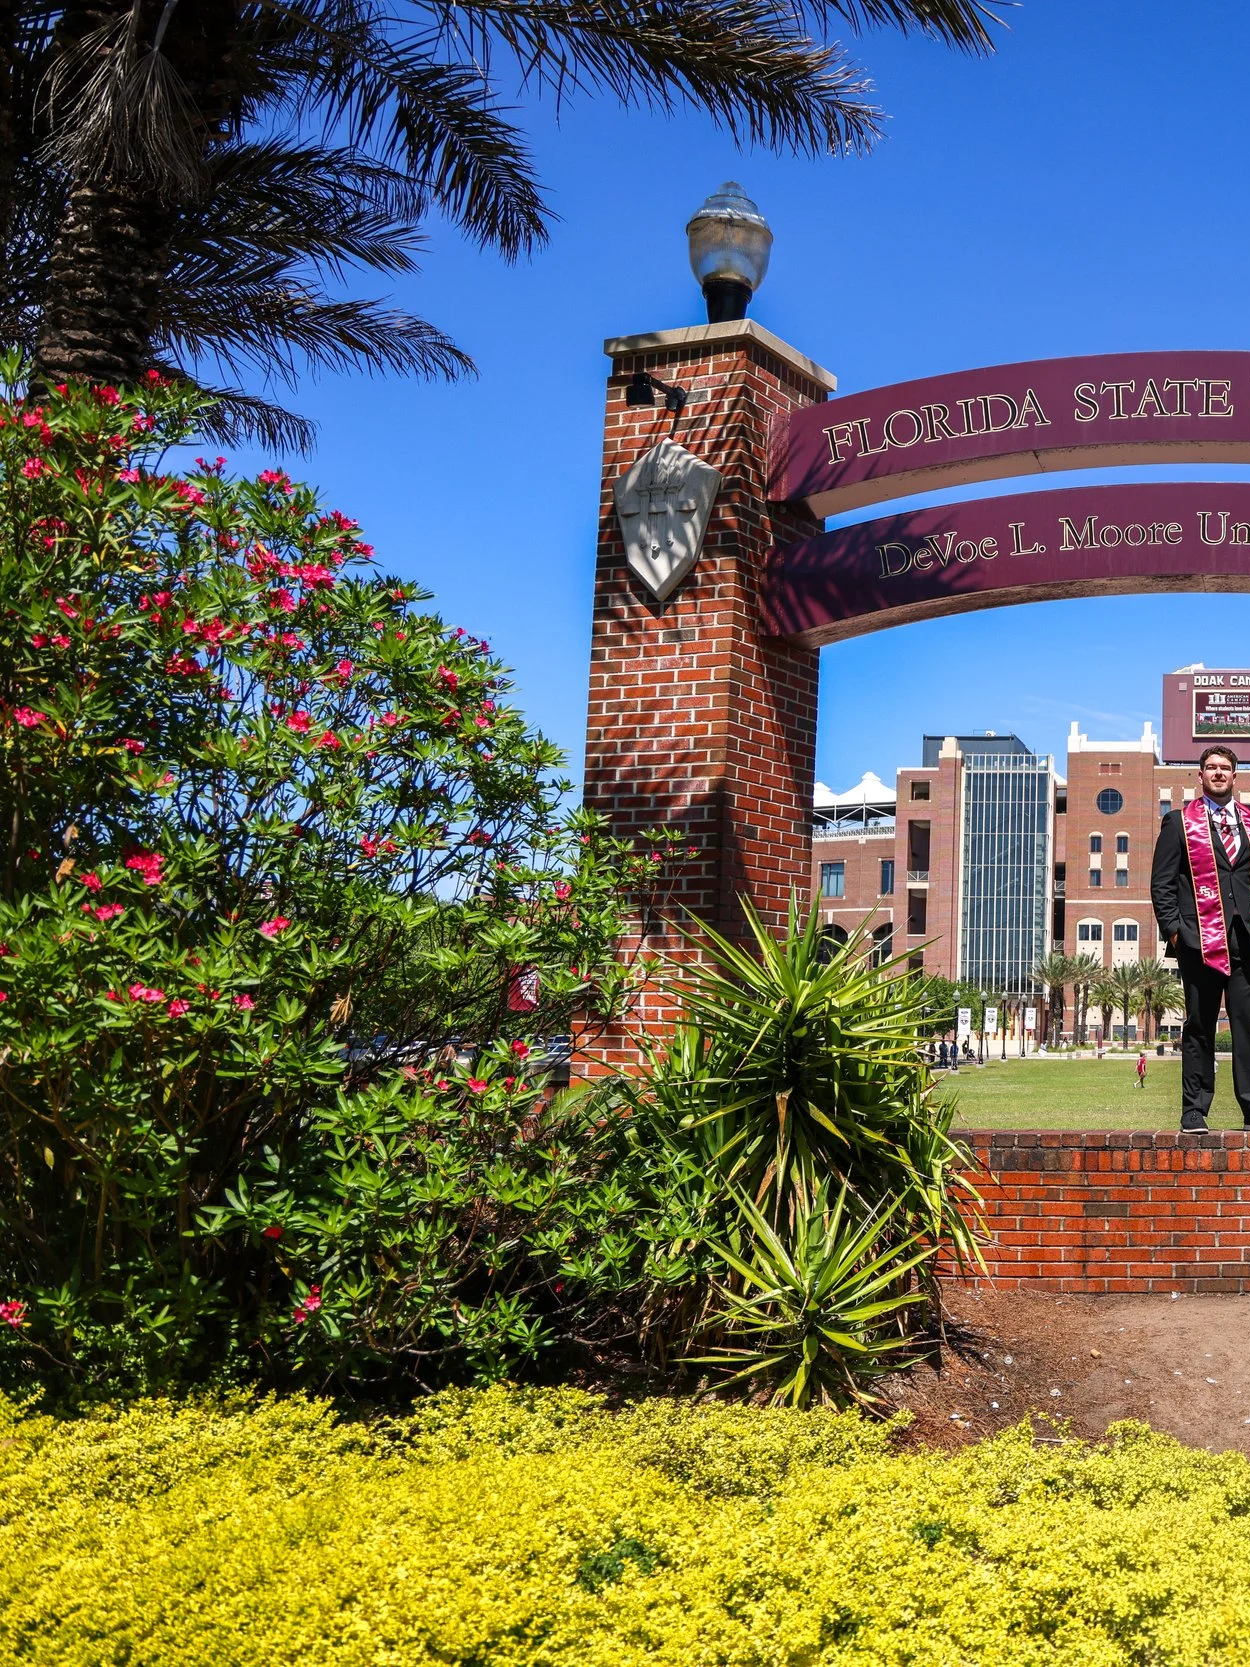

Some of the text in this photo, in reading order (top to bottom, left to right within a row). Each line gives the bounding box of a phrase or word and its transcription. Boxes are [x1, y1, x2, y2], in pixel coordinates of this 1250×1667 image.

[822, 388, 1051, 465] FLORIDA
[1073, 378, 1234, 422] STATE
[876, 531, 998, 579] DeVoe
[1008, 522, 1046, 556] L.
[1058, 515, 1183, 551] Moore
[1194, 675, 1225, 687] DOAK
